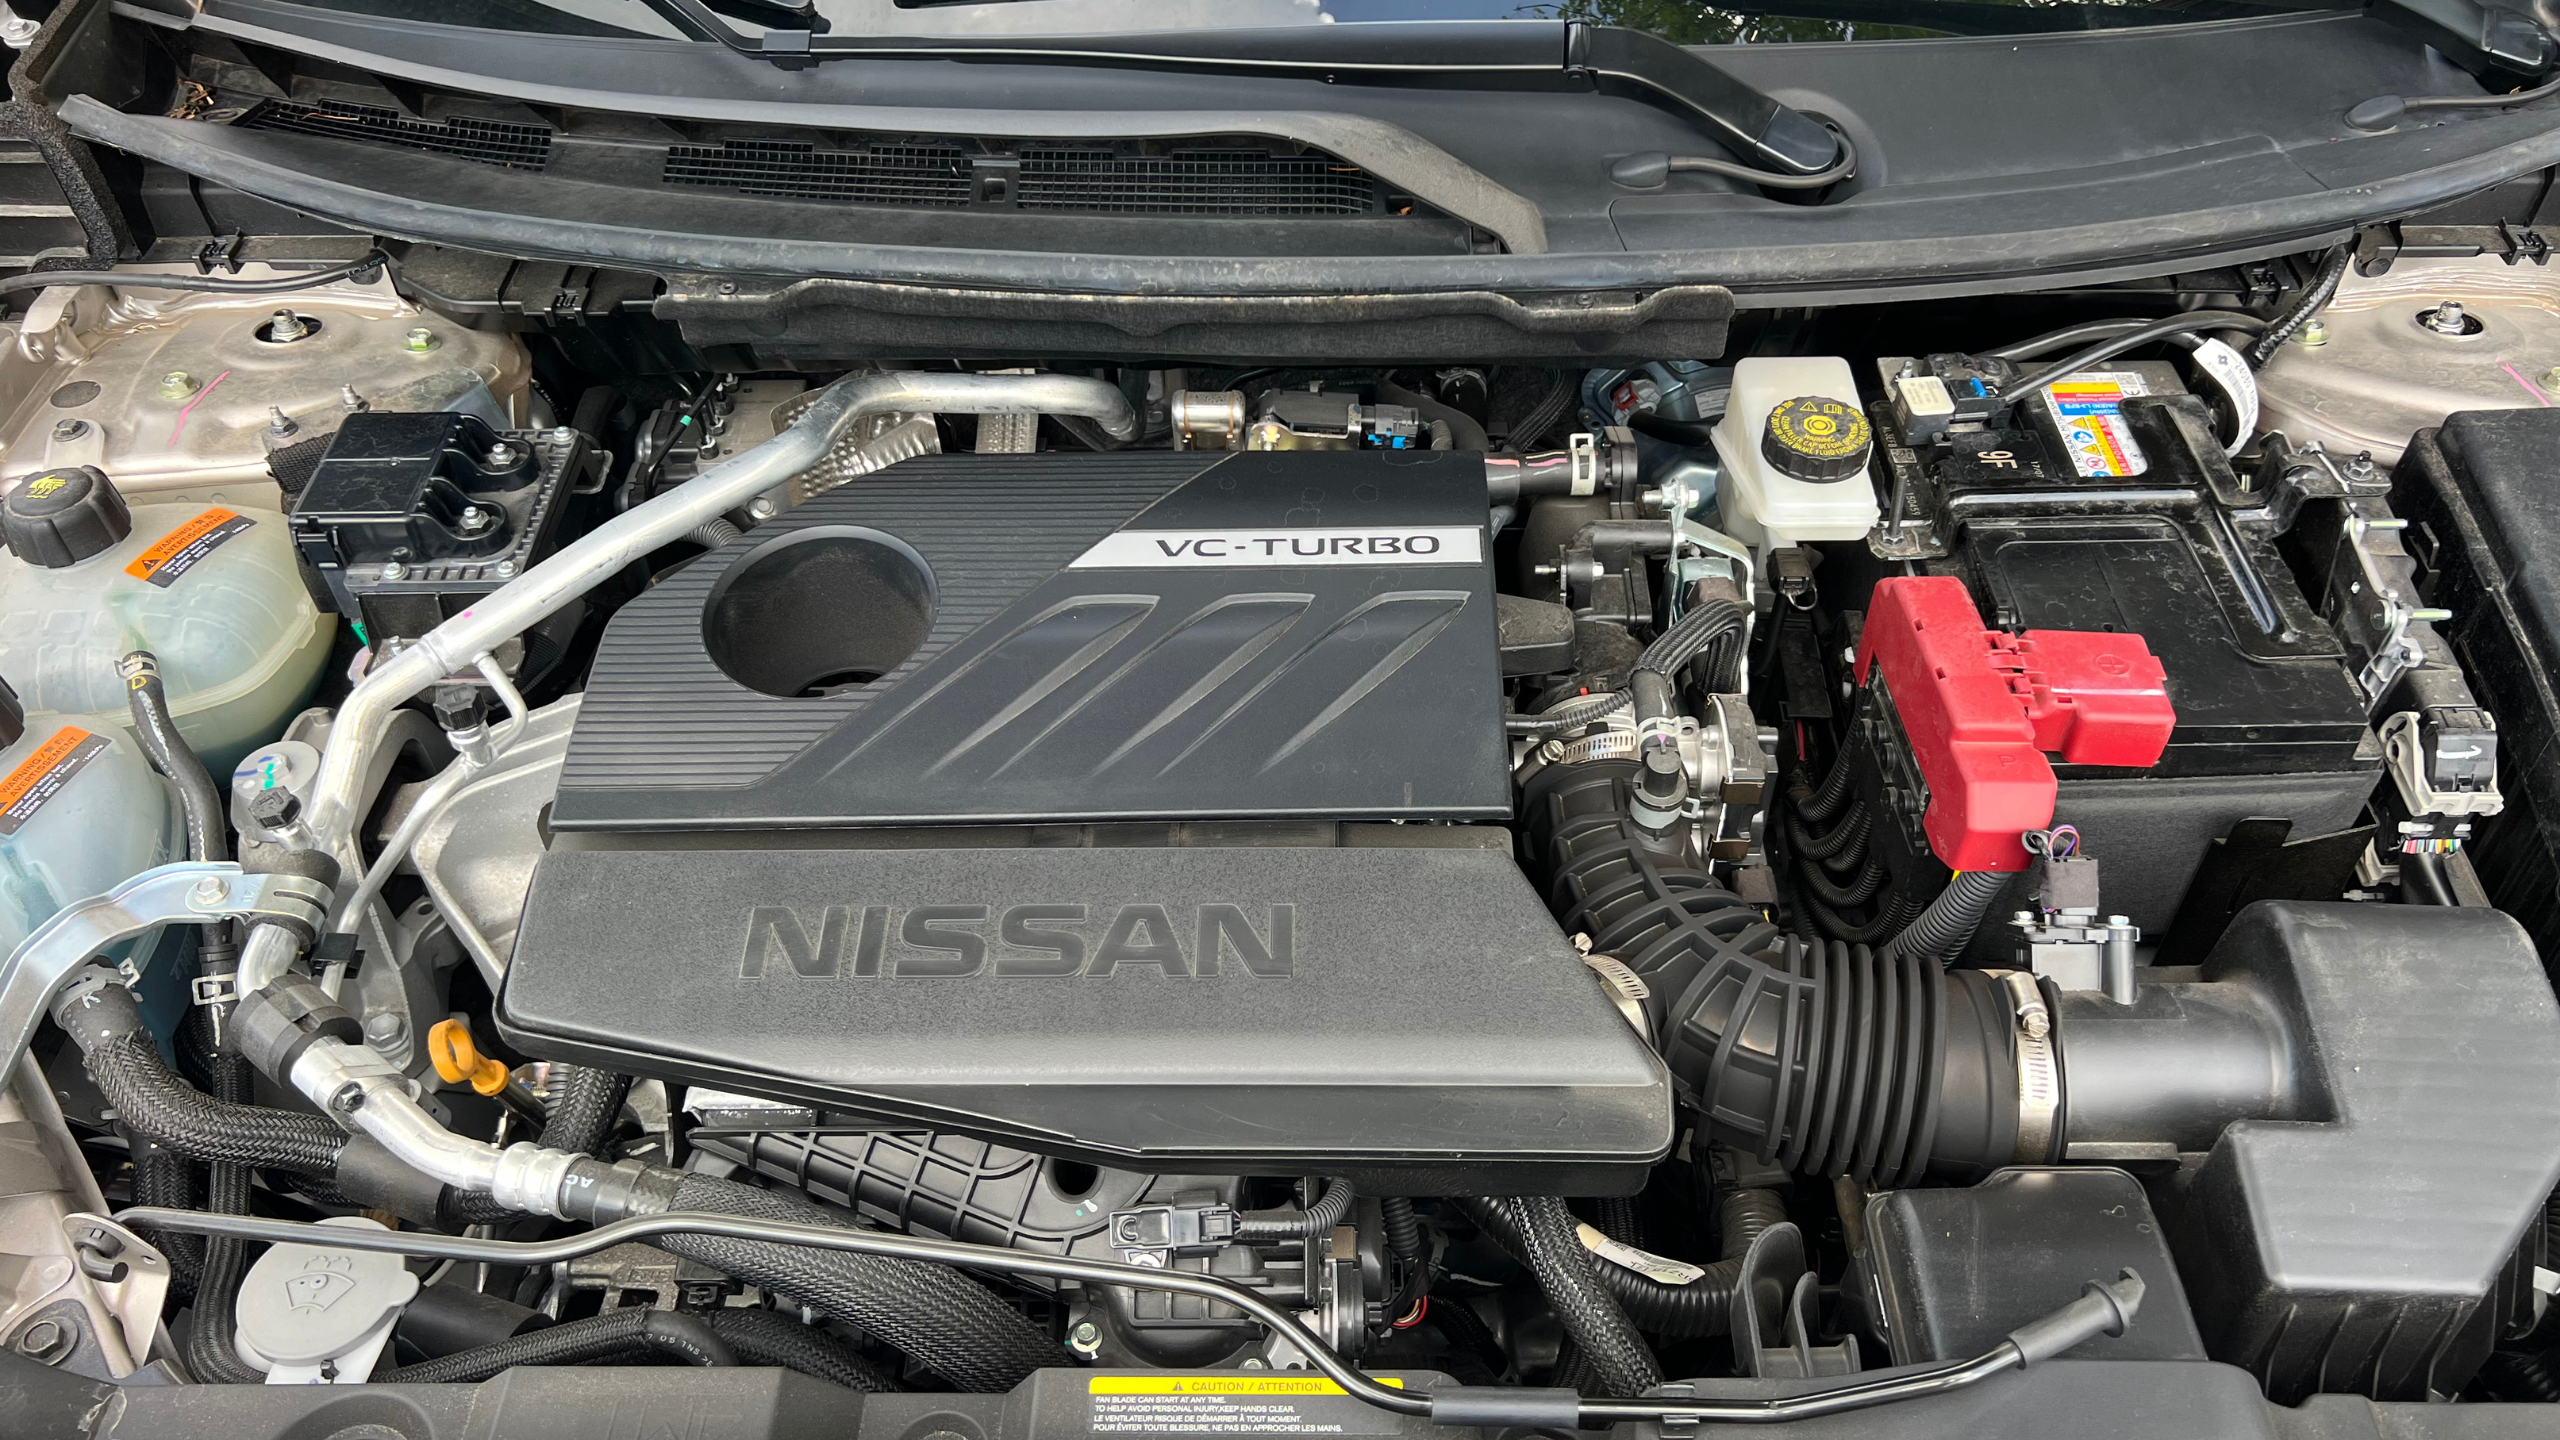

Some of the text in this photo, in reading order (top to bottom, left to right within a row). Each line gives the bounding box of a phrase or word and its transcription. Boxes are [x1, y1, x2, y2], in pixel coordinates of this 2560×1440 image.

[1792, 442, 1814, 454] BRAKE
[1815, 448, 1836, 456] FLUID
[1819, 440, 1844, 450] BEFORE
[2064, 434, 2081, 462] NISSAN
[1977, 450, 2018, 469] 9F
[2031, 461, 2045, 479] 17/07
[1906, 492, 1920, 516] 150459
[154, 526, 193, 553] WARNING
[164, 515, 225, 556] AVERTISSEMENT
[1156, 535, 1440, 557] VC-TURBO
[10, 736, 78, 797] AVERTISSEMENT
[1, 758, 42, 794] WARNING
[738, 902, 1295, 980] NISSAN
[565, 1174, 594, 1189] AC
[1192, 1382, 1244, 1392] CAUTION
[1258, 1382, 1322, 1392] ATTENTION
[1094, 1404, 1106, 1413] TO
[1106, 1404, 1126, 1413] HELP
[1127, 1404, 1151, 1413] AVOID
[1152, 1404, 1192, 1413] PERSONAL
[1240, 1404, 1268, 1413] HANDS
[1268, 1404, 1295, 1413] CLEAR.
[1096, 1396, 1226, 1404] FAN BLADE CAN START AT ANY TIME.
[1094, 1413, 1302, 1422] LE VENTILATEUR RISQUE DE DÉMARRER À TOUT MOMENT.
[1093, 1422, 1343, 1432] POUR ÉVITER TOUTE BLESSURE, NE PAS EN APPROCHER LES MAINS.
